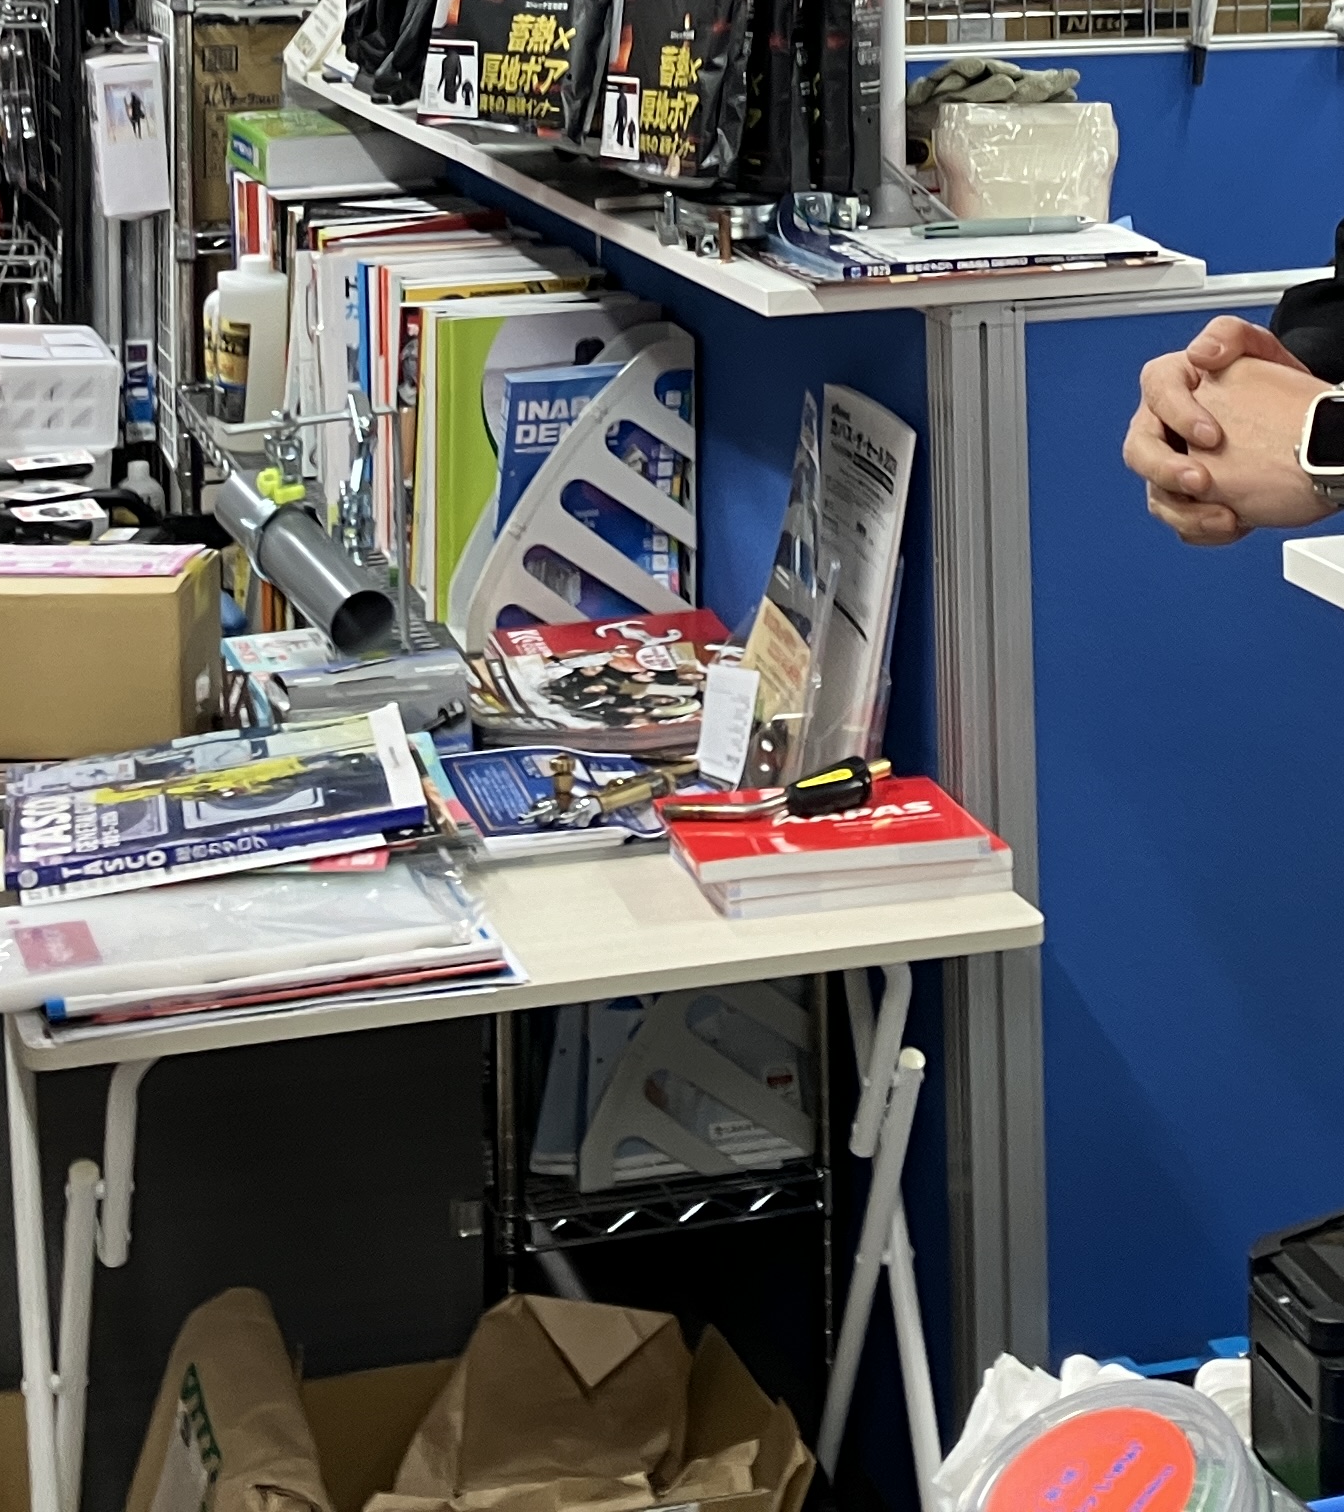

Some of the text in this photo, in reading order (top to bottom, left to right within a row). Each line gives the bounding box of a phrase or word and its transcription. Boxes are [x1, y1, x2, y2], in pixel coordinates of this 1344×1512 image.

[480, 53, 570, 95] 厚地ボア
[61, 849, 167, 880] TASCO
